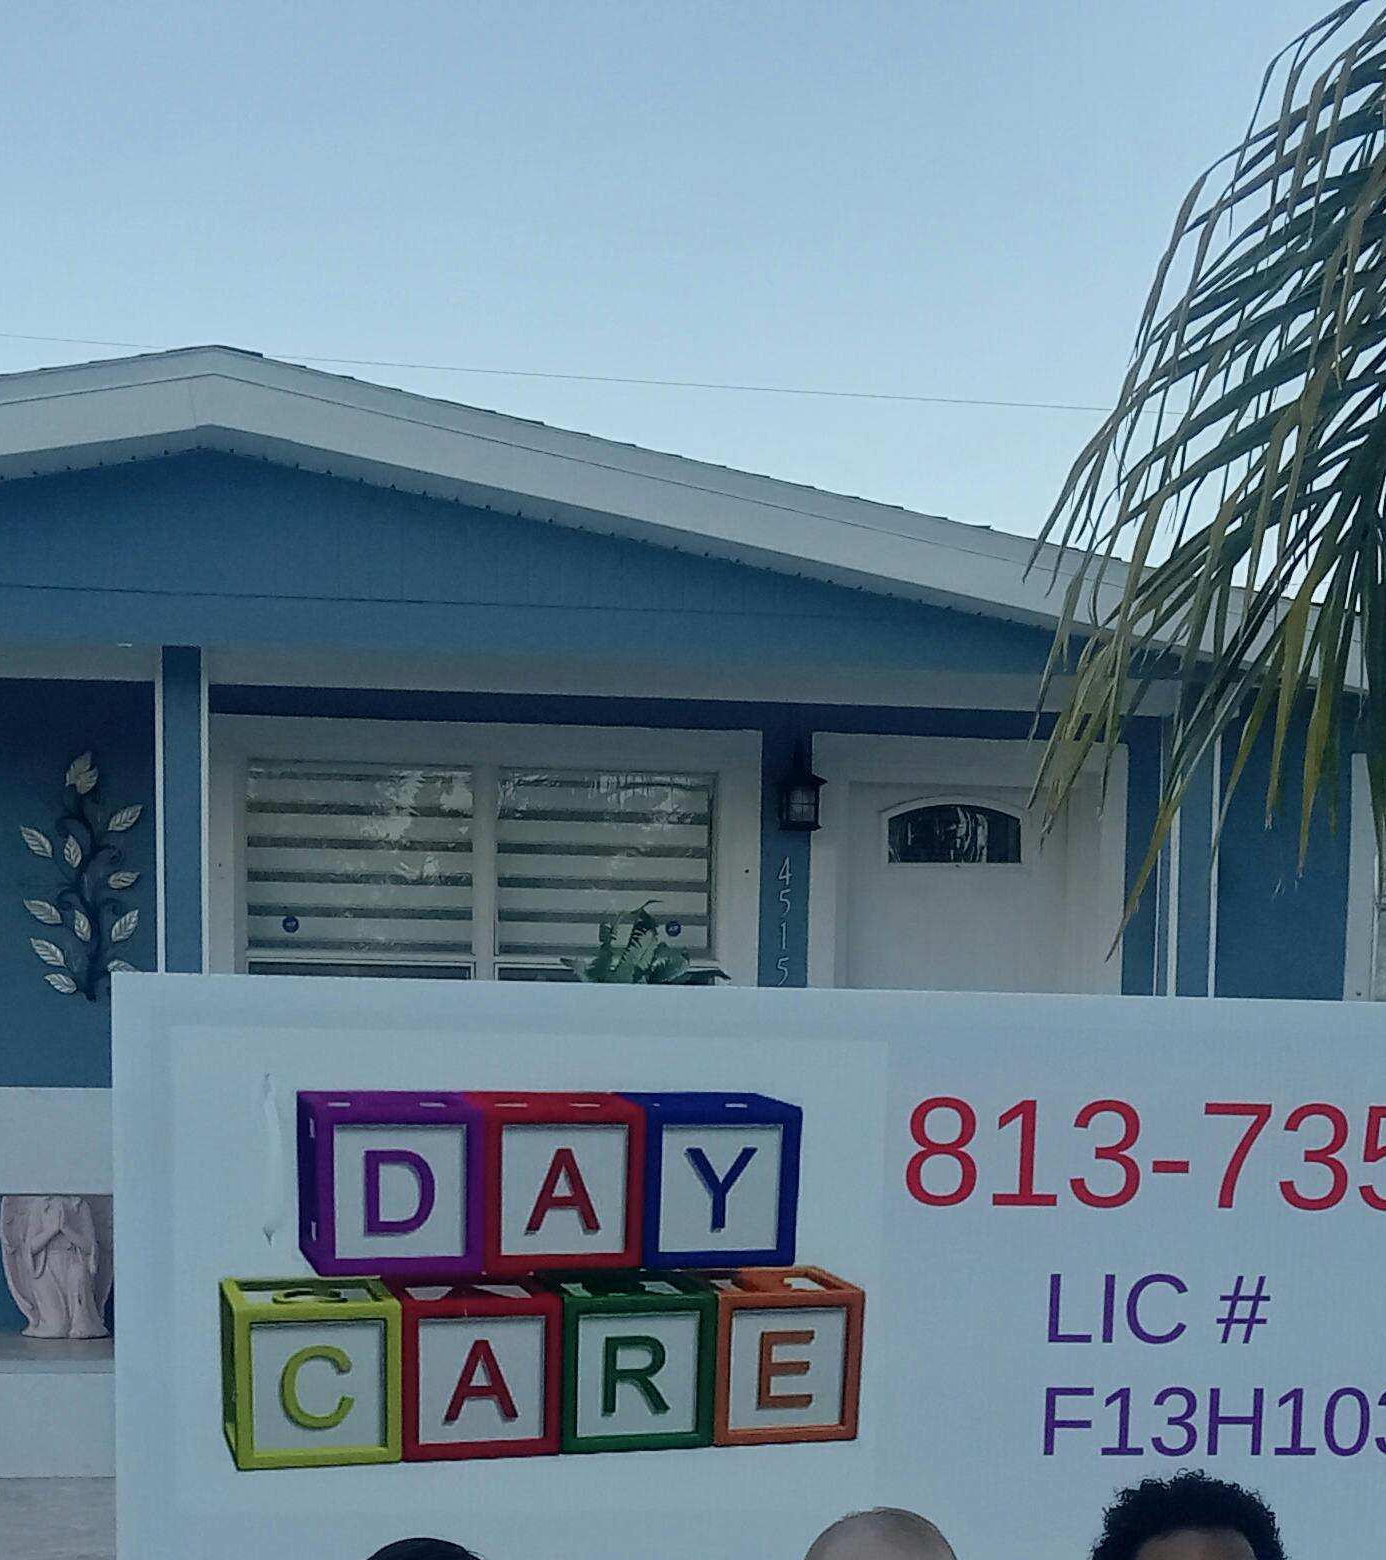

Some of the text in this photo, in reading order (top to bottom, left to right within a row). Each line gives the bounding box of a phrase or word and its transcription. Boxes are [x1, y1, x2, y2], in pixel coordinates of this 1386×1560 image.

[777, 856, 793, 987] 4515
[363, 1146, 757, 1237] DAY
[1046, 1273, 1272, 1345] LIC #
[279, 1329, 816, 1430] CARE
